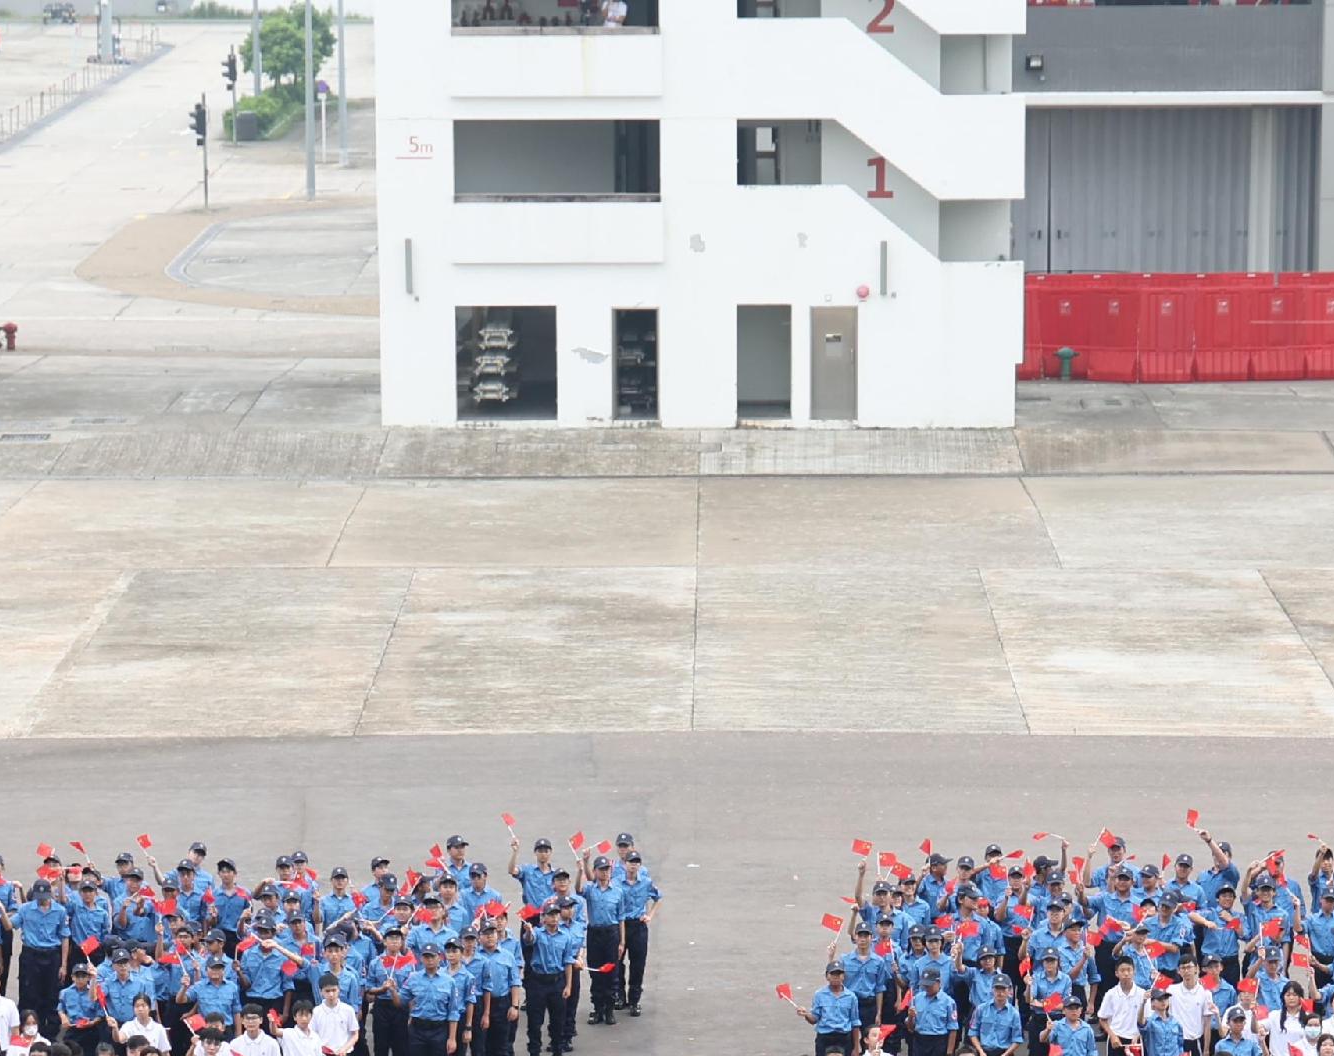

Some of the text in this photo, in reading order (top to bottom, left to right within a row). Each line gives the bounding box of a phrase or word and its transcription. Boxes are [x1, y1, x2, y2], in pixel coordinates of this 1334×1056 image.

[866, 0, 894, 33] 2
[409, 136, 434, 153] 5m
[866, 156, 894, 199] 1
